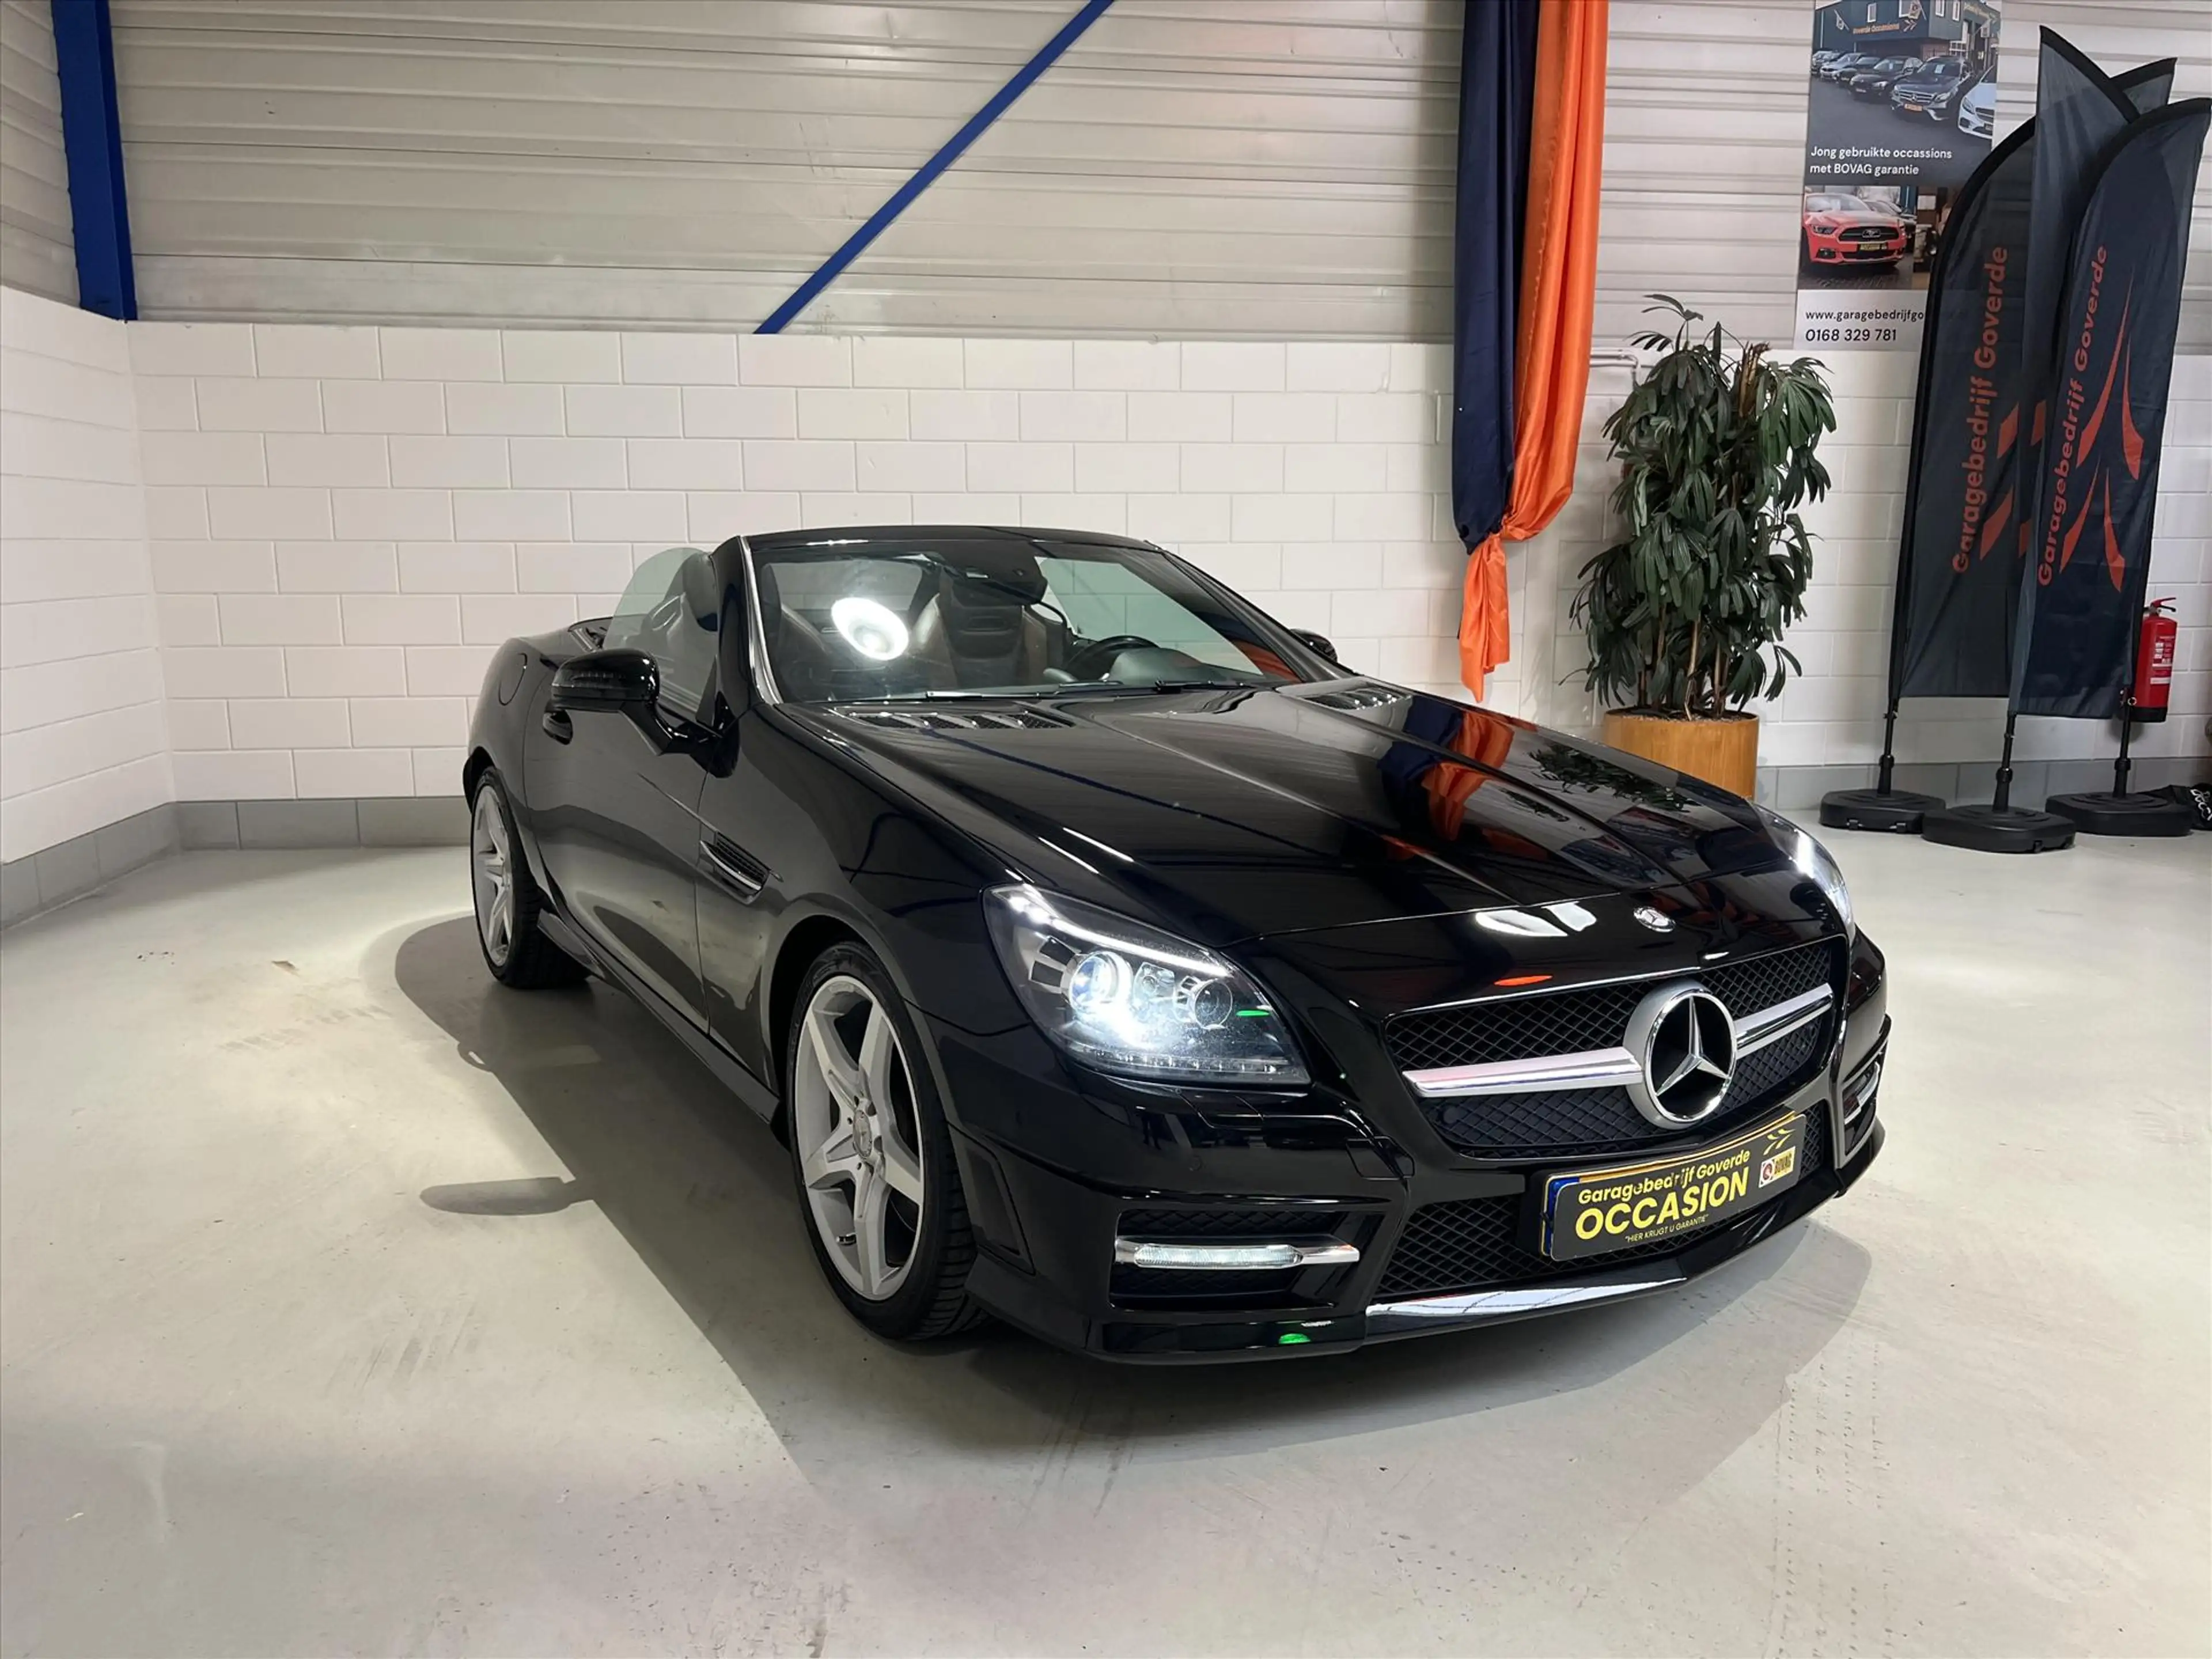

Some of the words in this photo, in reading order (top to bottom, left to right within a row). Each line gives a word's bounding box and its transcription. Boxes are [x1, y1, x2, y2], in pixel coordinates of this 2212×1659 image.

[1810, 146, 1836, 159] Jong
[1838, 146, 1891, 160] gebruikte
[1893, 147, 1952, 159] occassions
[1810, 164, 1832, 173] met
[1834, 164, 1872, 174] BOVAG
[1874, 164, 1919, 177] garantie
[1805, 329, 1839, 342] 0168
[1844, 329, 1870, 342] 329
[1875, 329, 1897, 342] 781
[1974, 247, 2008, 369] Goverde
[2038, 378, 2085, 586] Garagebedrijf
[2075, 245, 2107, 372] Goverde
[1952, 376, 1998, 573] Garagebedrijf
[1575, 1166, 1749, 1240] OCCASION
[1578, 1166, 1695, 1205] Garagebedrijf
[1696, 1150, 1751, 1179] Goverde
[1669, 1224, 1675, 1233] U
